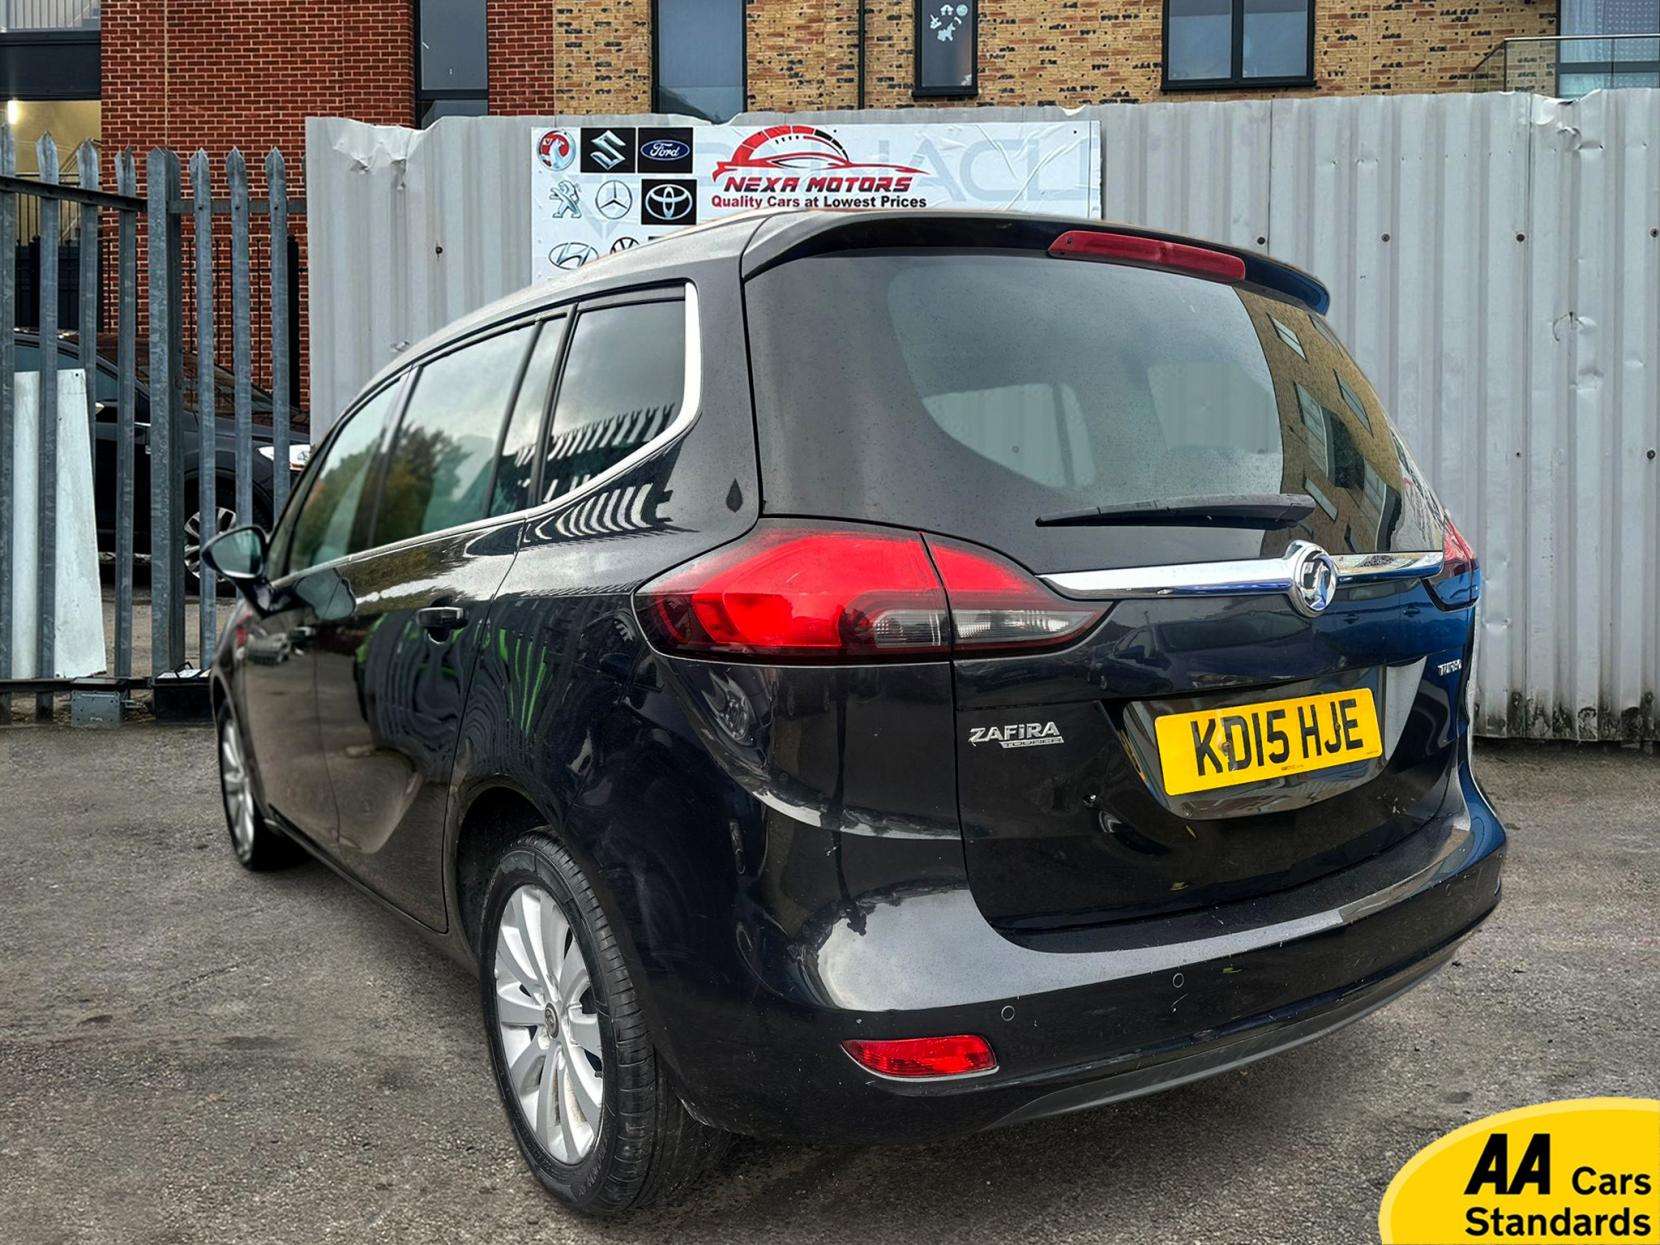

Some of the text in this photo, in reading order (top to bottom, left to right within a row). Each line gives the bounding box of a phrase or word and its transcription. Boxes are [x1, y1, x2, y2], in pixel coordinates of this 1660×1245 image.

[650, 142, 681, 157] Ford
[723, 176, 913, 193] NEXA MOTORS
[711, 195, 927, 210] Quality Cars at Lowest Prices
[968, 721, 1060, 746] ZAFIRA
[1190, 698, 1364, 777] KD15 HJE
